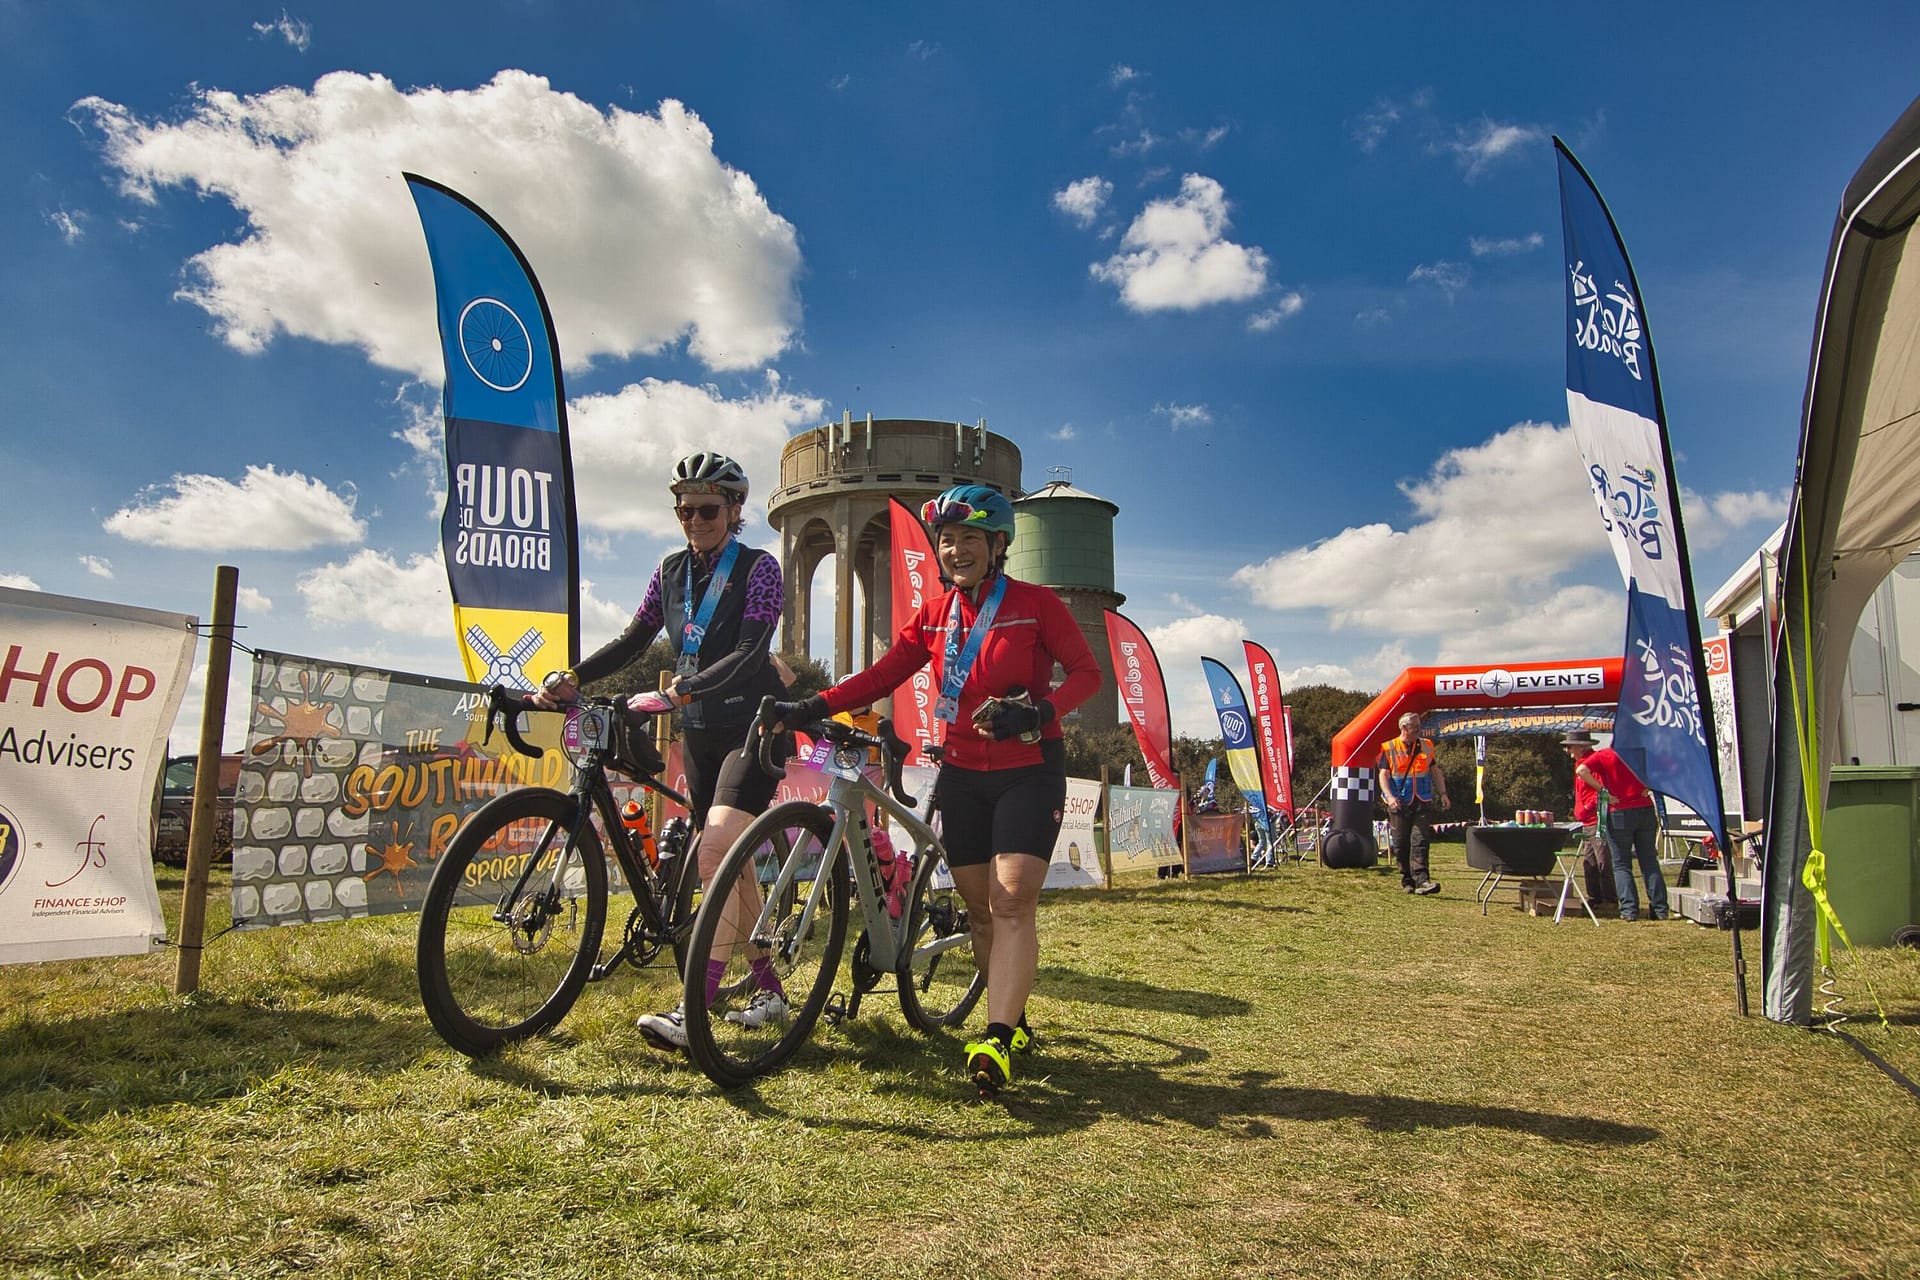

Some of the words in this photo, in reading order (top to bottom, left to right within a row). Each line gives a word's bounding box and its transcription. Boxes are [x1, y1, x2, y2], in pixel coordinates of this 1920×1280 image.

[0, 644, 156, 718] HOP
[1439, 679, 1478, 690] TPR
[1516, 673, 1600, 688] EVENTS
[1439, 710, 1506, 734] SUFFOLK
[1508, 710, 1585, 730] ROUBAIX
[1583, 719, 1615, 731] SPORT
[0, 726, 135, 772] Advisers
[405, 728, 443, 753] THE
[813, 744, 830, 764] 188
[344, 748, 564, 819] SOUTHWOLD
[1070, 797, 1094, 815] SHOP
[465, 848, 561, 887] SPORTVE
[32, 909, 71, 917] Independent
[34, 898, 91, 908] FINANCE
[93, 896, 127, 907] SHOP
